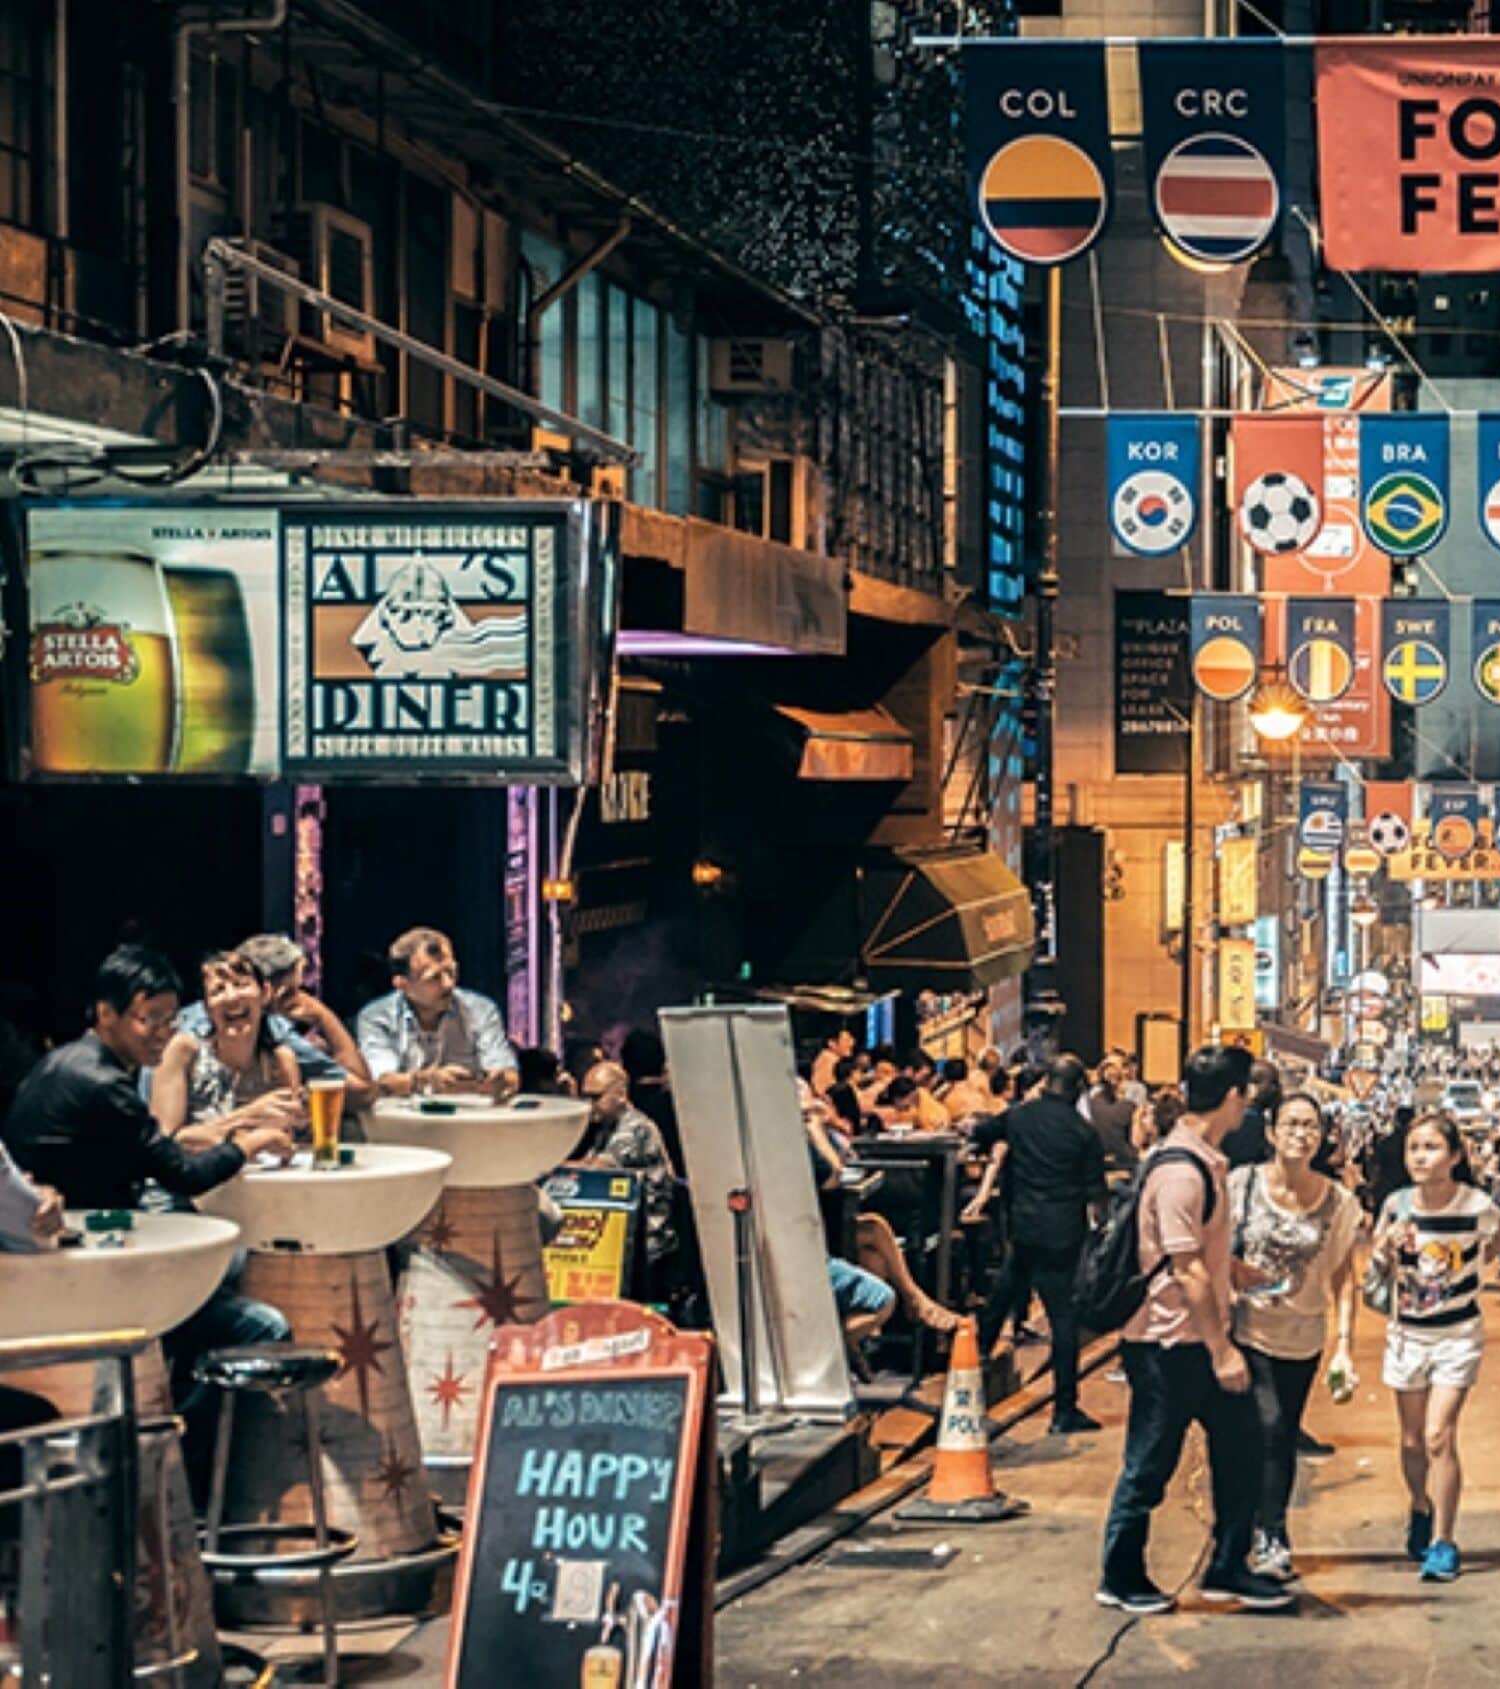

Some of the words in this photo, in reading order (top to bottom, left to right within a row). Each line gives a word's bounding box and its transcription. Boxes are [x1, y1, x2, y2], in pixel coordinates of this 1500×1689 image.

[1000, 88, 1076, 119] COL
[1175, 87, 1248, 118] CRC
[1127, 440, 1179, 463] KOR
[1382, 442, 1427, 464] BRA
[152, 528, 204, 539] STELLA
[221, 528, 272, 539] ARTOIS
[319, 553, 516, 600] AL'S
[1205, 615, 1243, 632] POL
[1302, 617, 1339, 633] FRA
[1396, 619, 1436, 636] SWE
[43, 635, 120, 650] STELLA
[43, 652, 122, 669] ARTOIS
[322, 684, 522, 729] DINER
[516, 1448, 673, 1502] HAPPY
[531, 1505, 649, 1553] HOUR
